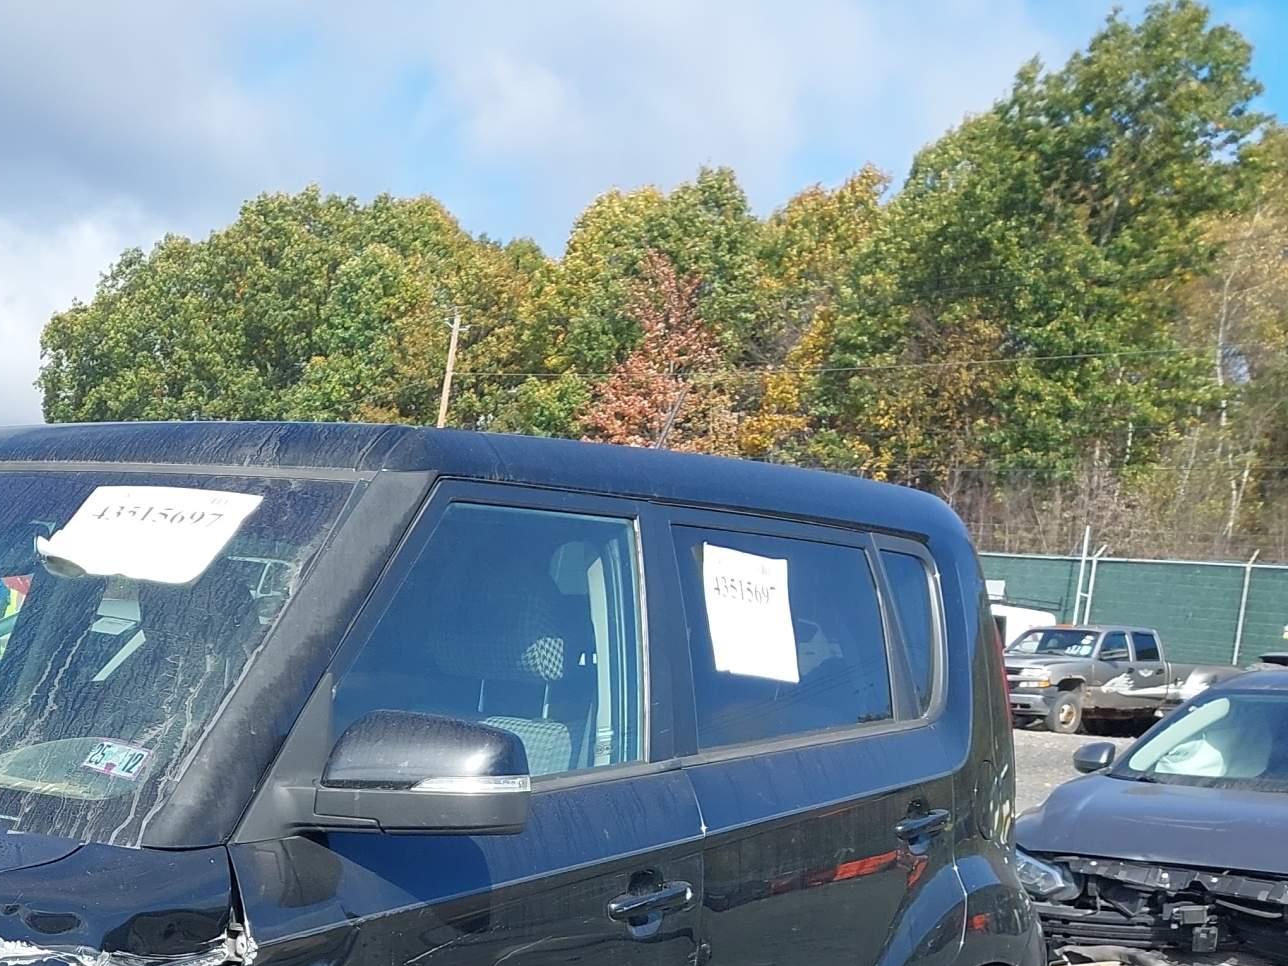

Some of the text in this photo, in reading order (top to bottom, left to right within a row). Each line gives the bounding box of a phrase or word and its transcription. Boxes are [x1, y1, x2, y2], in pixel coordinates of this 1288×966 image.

[91, 504, 225, 528] 43515697
[88, 742, 145, 774] 25 12
